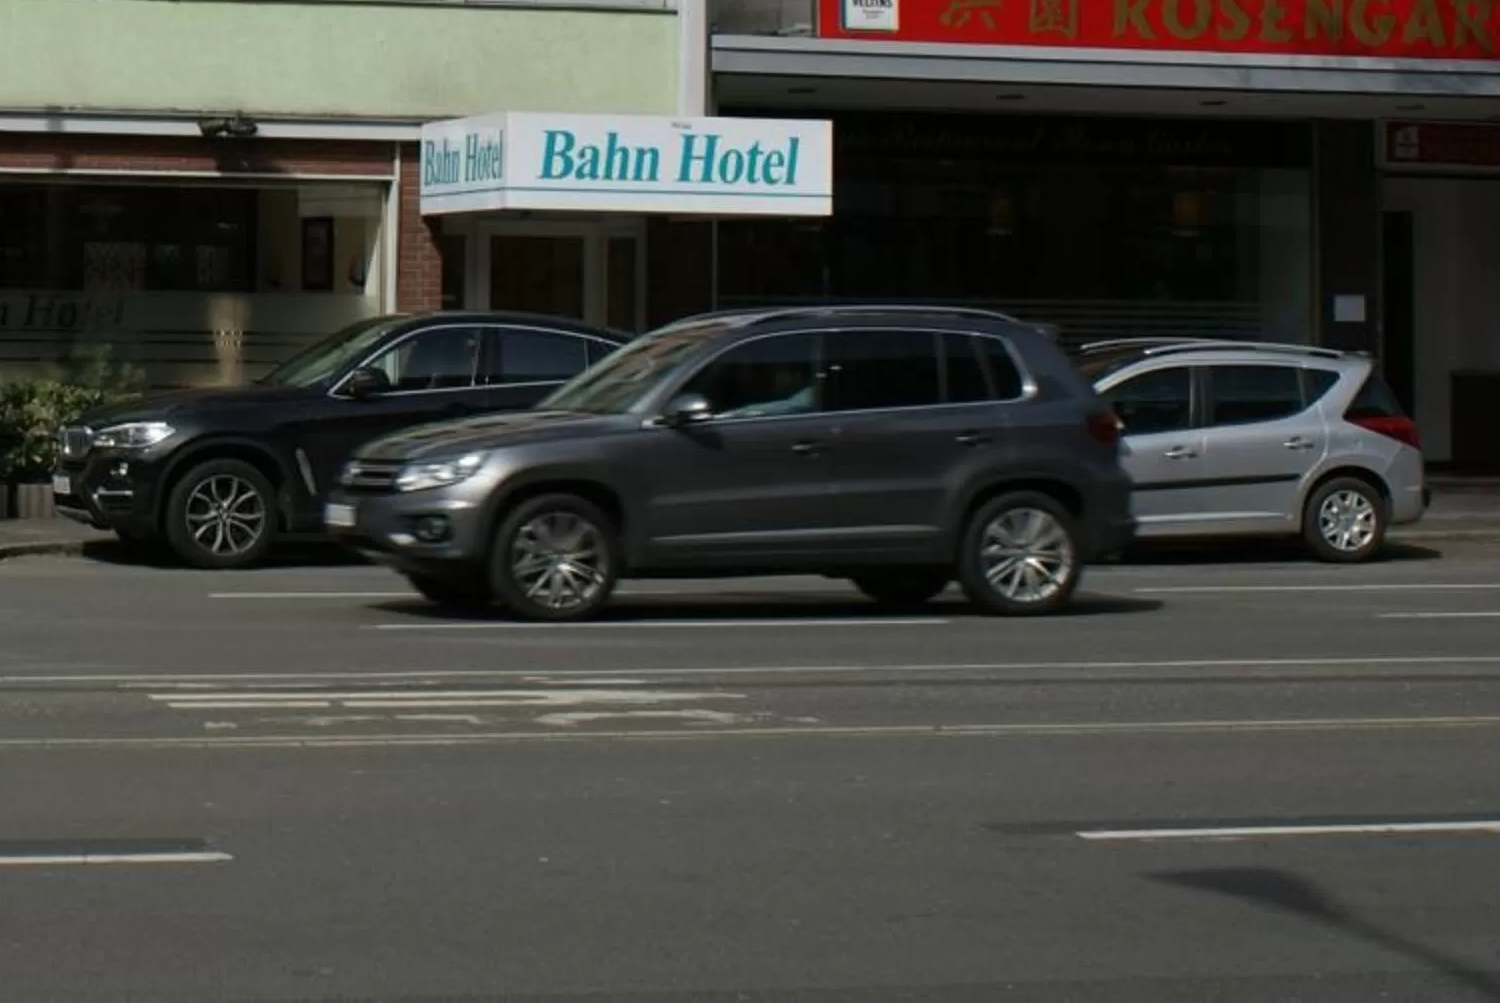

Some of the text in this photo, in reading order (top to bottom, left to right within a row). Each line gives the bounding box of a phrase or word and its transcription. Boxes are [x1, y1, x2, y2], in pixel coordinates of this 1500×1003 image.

[423, 130, 503, 186] Bahn Hotel
[538, 129, 660, 182] Bahn
[675, 133, 800, 185] Hotel
